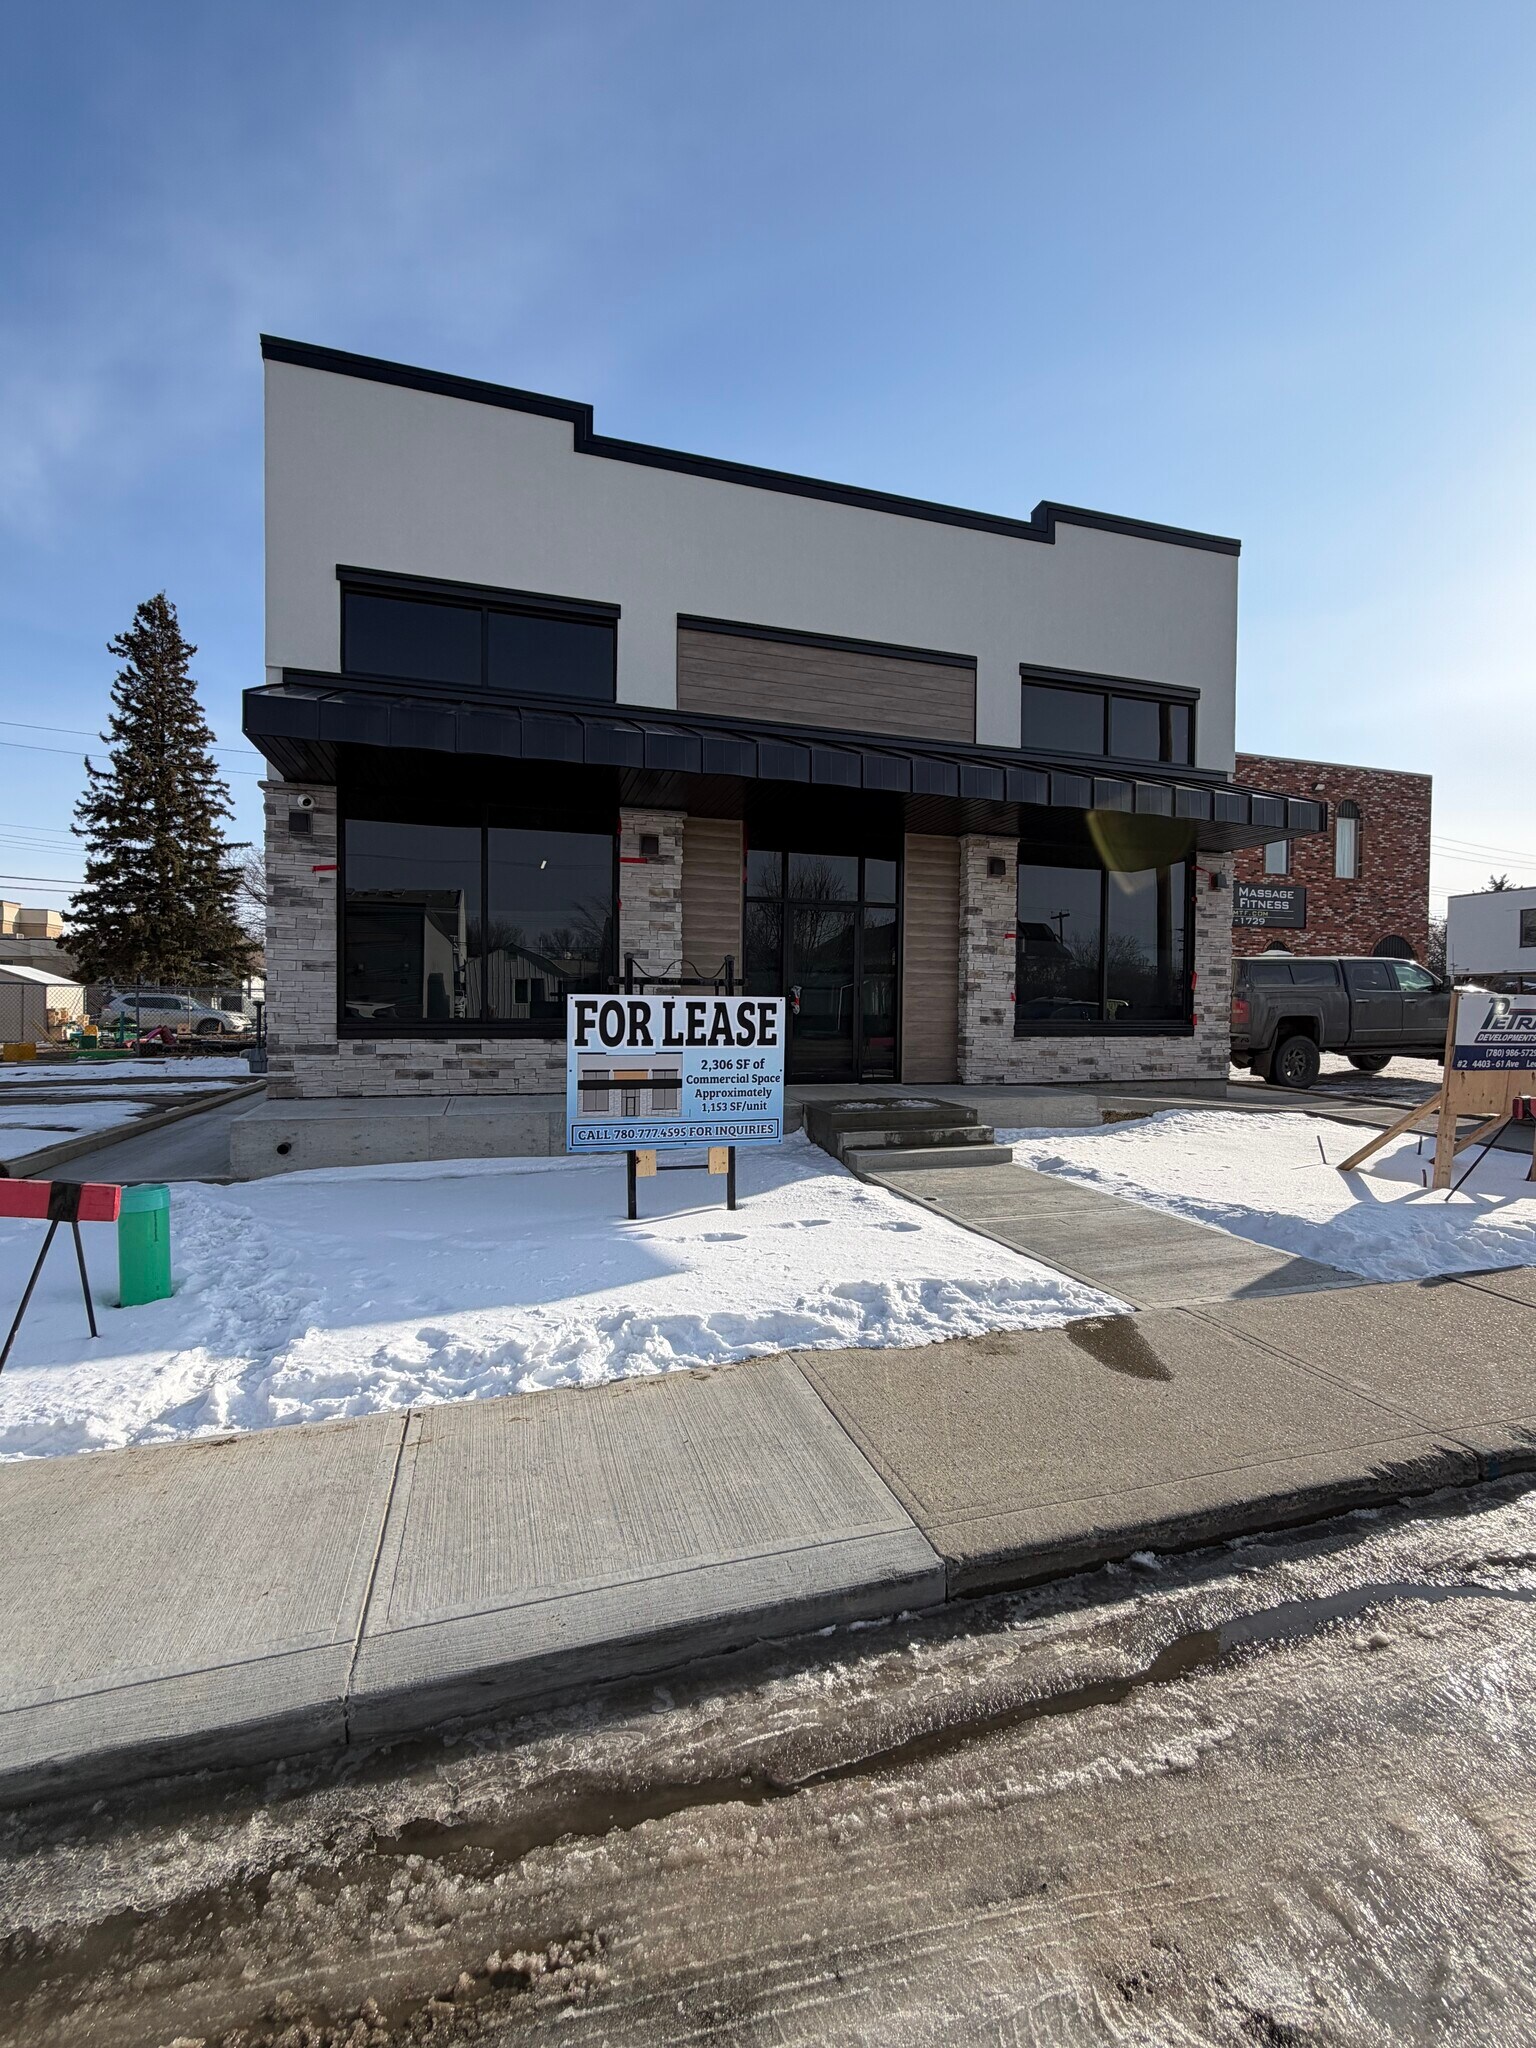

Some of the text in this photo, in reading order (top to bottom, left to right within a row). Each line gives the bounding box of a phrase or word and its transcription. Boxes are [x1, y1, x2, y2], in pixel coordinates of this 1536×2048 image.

[1238, 886, 1294, 899] MASSAGE
[1239, 898, 1289, 910] FITNESS
[1480, 997, 1536, 1030] PETR
[574, 1000, 777, 1047] FOR LEASE
[1486, 1048, 1505, 1058] (780)
[701, 1058, 766, 1072] 2,306 SF of
[1456, 1060, 1468, 1068] #2
[1471, 1060, 1491, 1068] 4403
[1495, 1060, 1504, 1068] 61
[1504, 1060, 1520, 1068] Ave
[686, 1073, 781, 1085] Commercial Space
[694, 1087, 773, 1101] Approximately
[701, 1100, 768, 1113] 1,153 SF/unit
[577, 1124, 774, 1141] CALL 780.777.4595 FOR INQUIRIES
